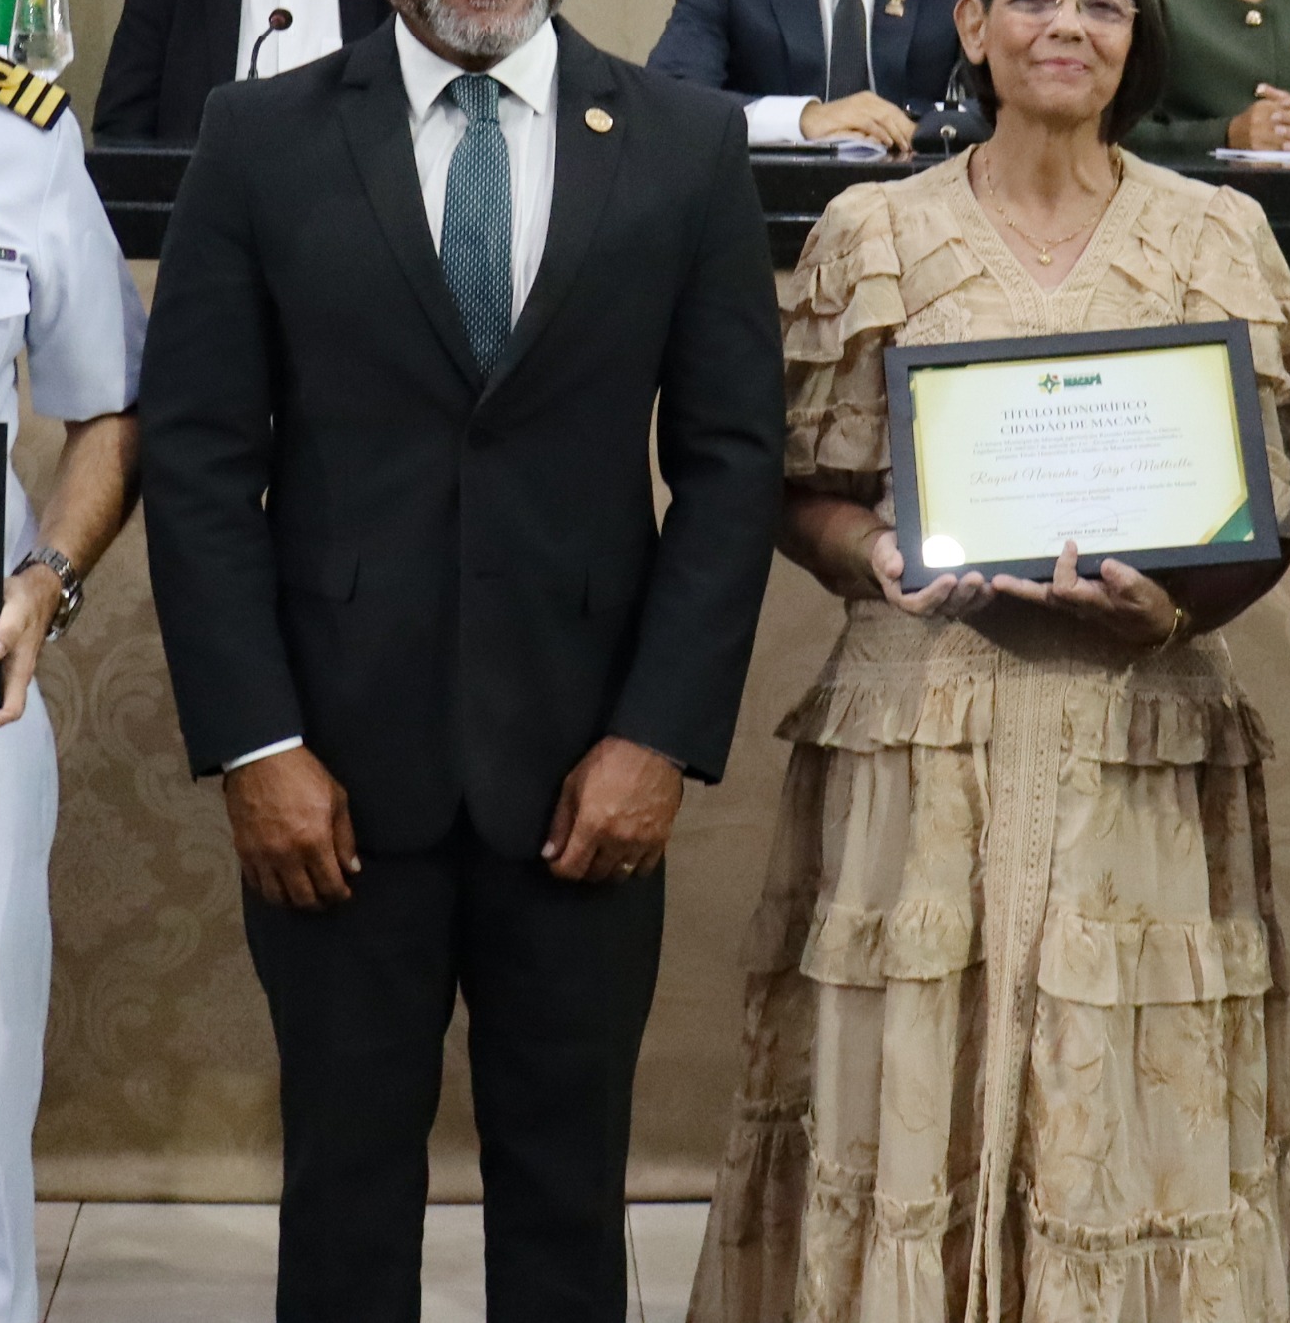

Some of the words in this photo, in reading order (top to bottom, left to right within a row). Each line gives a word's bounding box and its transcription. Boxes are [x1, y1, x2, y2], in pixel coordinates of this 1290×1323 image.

[1000, 405, 1054, 422] TÍTULO
[1056, 398, 1149, 418] HONORÍFICO
[1000, 420, 1067, 436] CIDADÃO
[1069, 419, 1088, 431] DE
[1091, 413, 1152, 429] MACAPÁ
